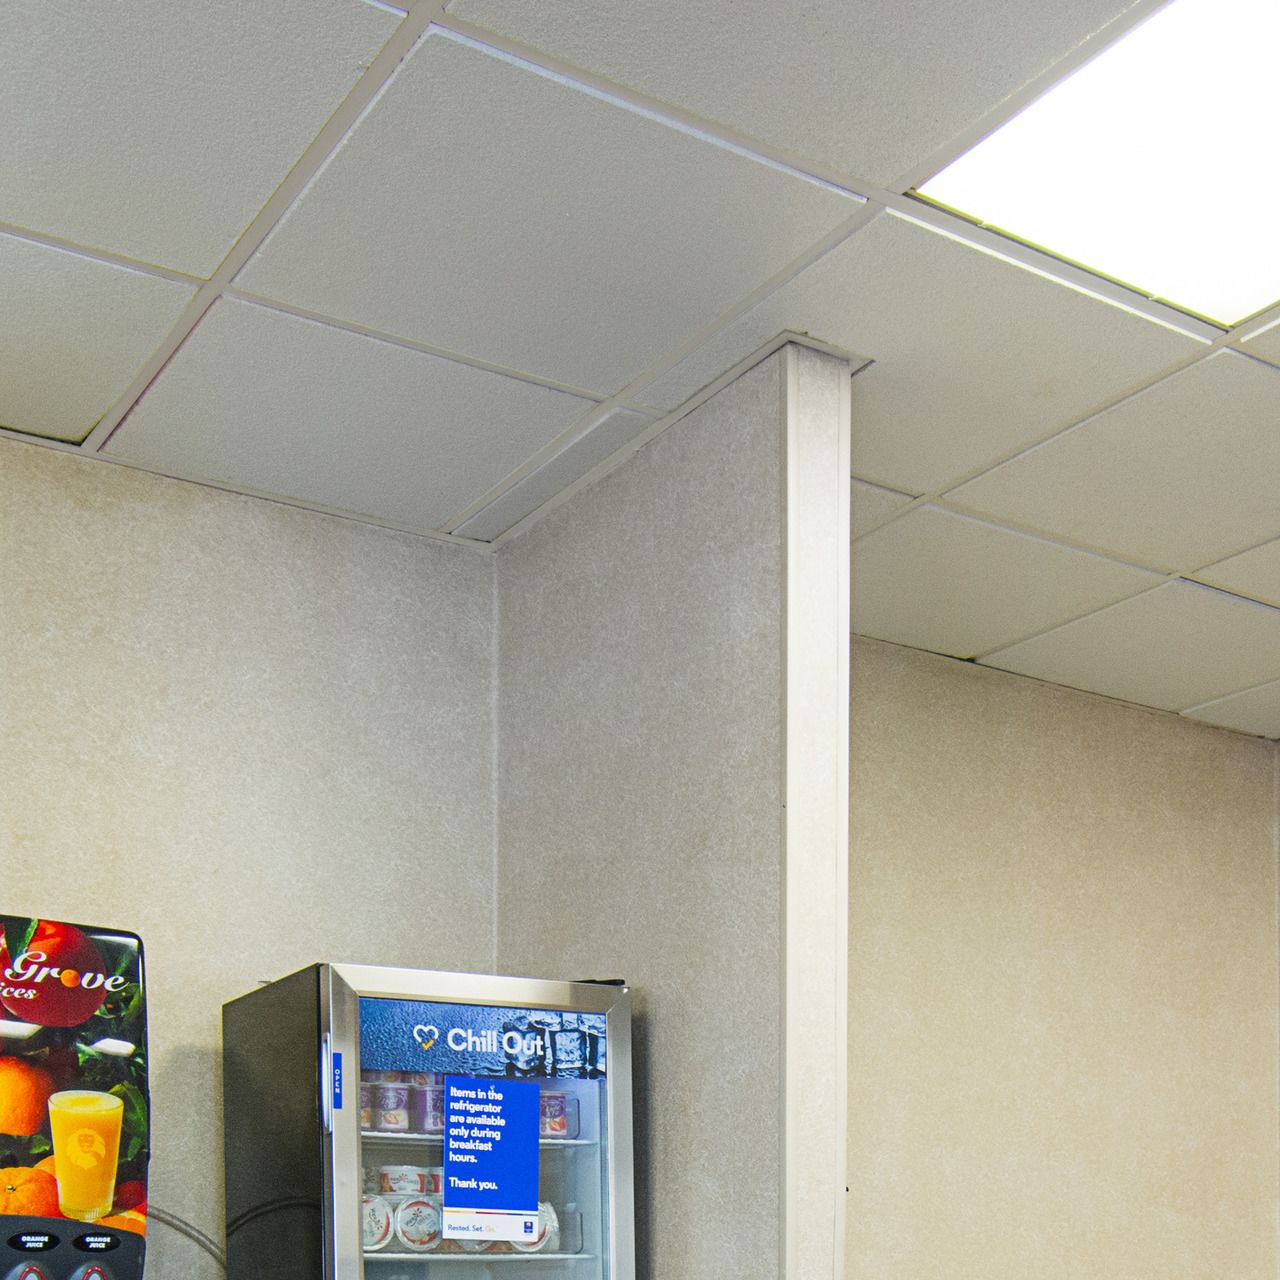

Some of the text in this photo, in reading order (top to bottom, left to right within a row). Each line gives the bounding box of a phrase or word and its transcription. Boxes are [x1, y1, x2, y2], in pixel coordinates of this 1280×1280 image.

[4, 950, 131, 993] Grove
[447, 1028, 544, 1055] Chill Out
[450, 1086, 504, 1101] Items in the
[449, 1100, 503, 1113] refrigerator
[449, 1114, 506, 1126] are available
[449, 1126, 501, 1141] only during
[449, 1137, 493, 1151] breakfast
[448, 1150, 478, 1163] hours.
[448, 1176, 499, 1191] Thank you.
